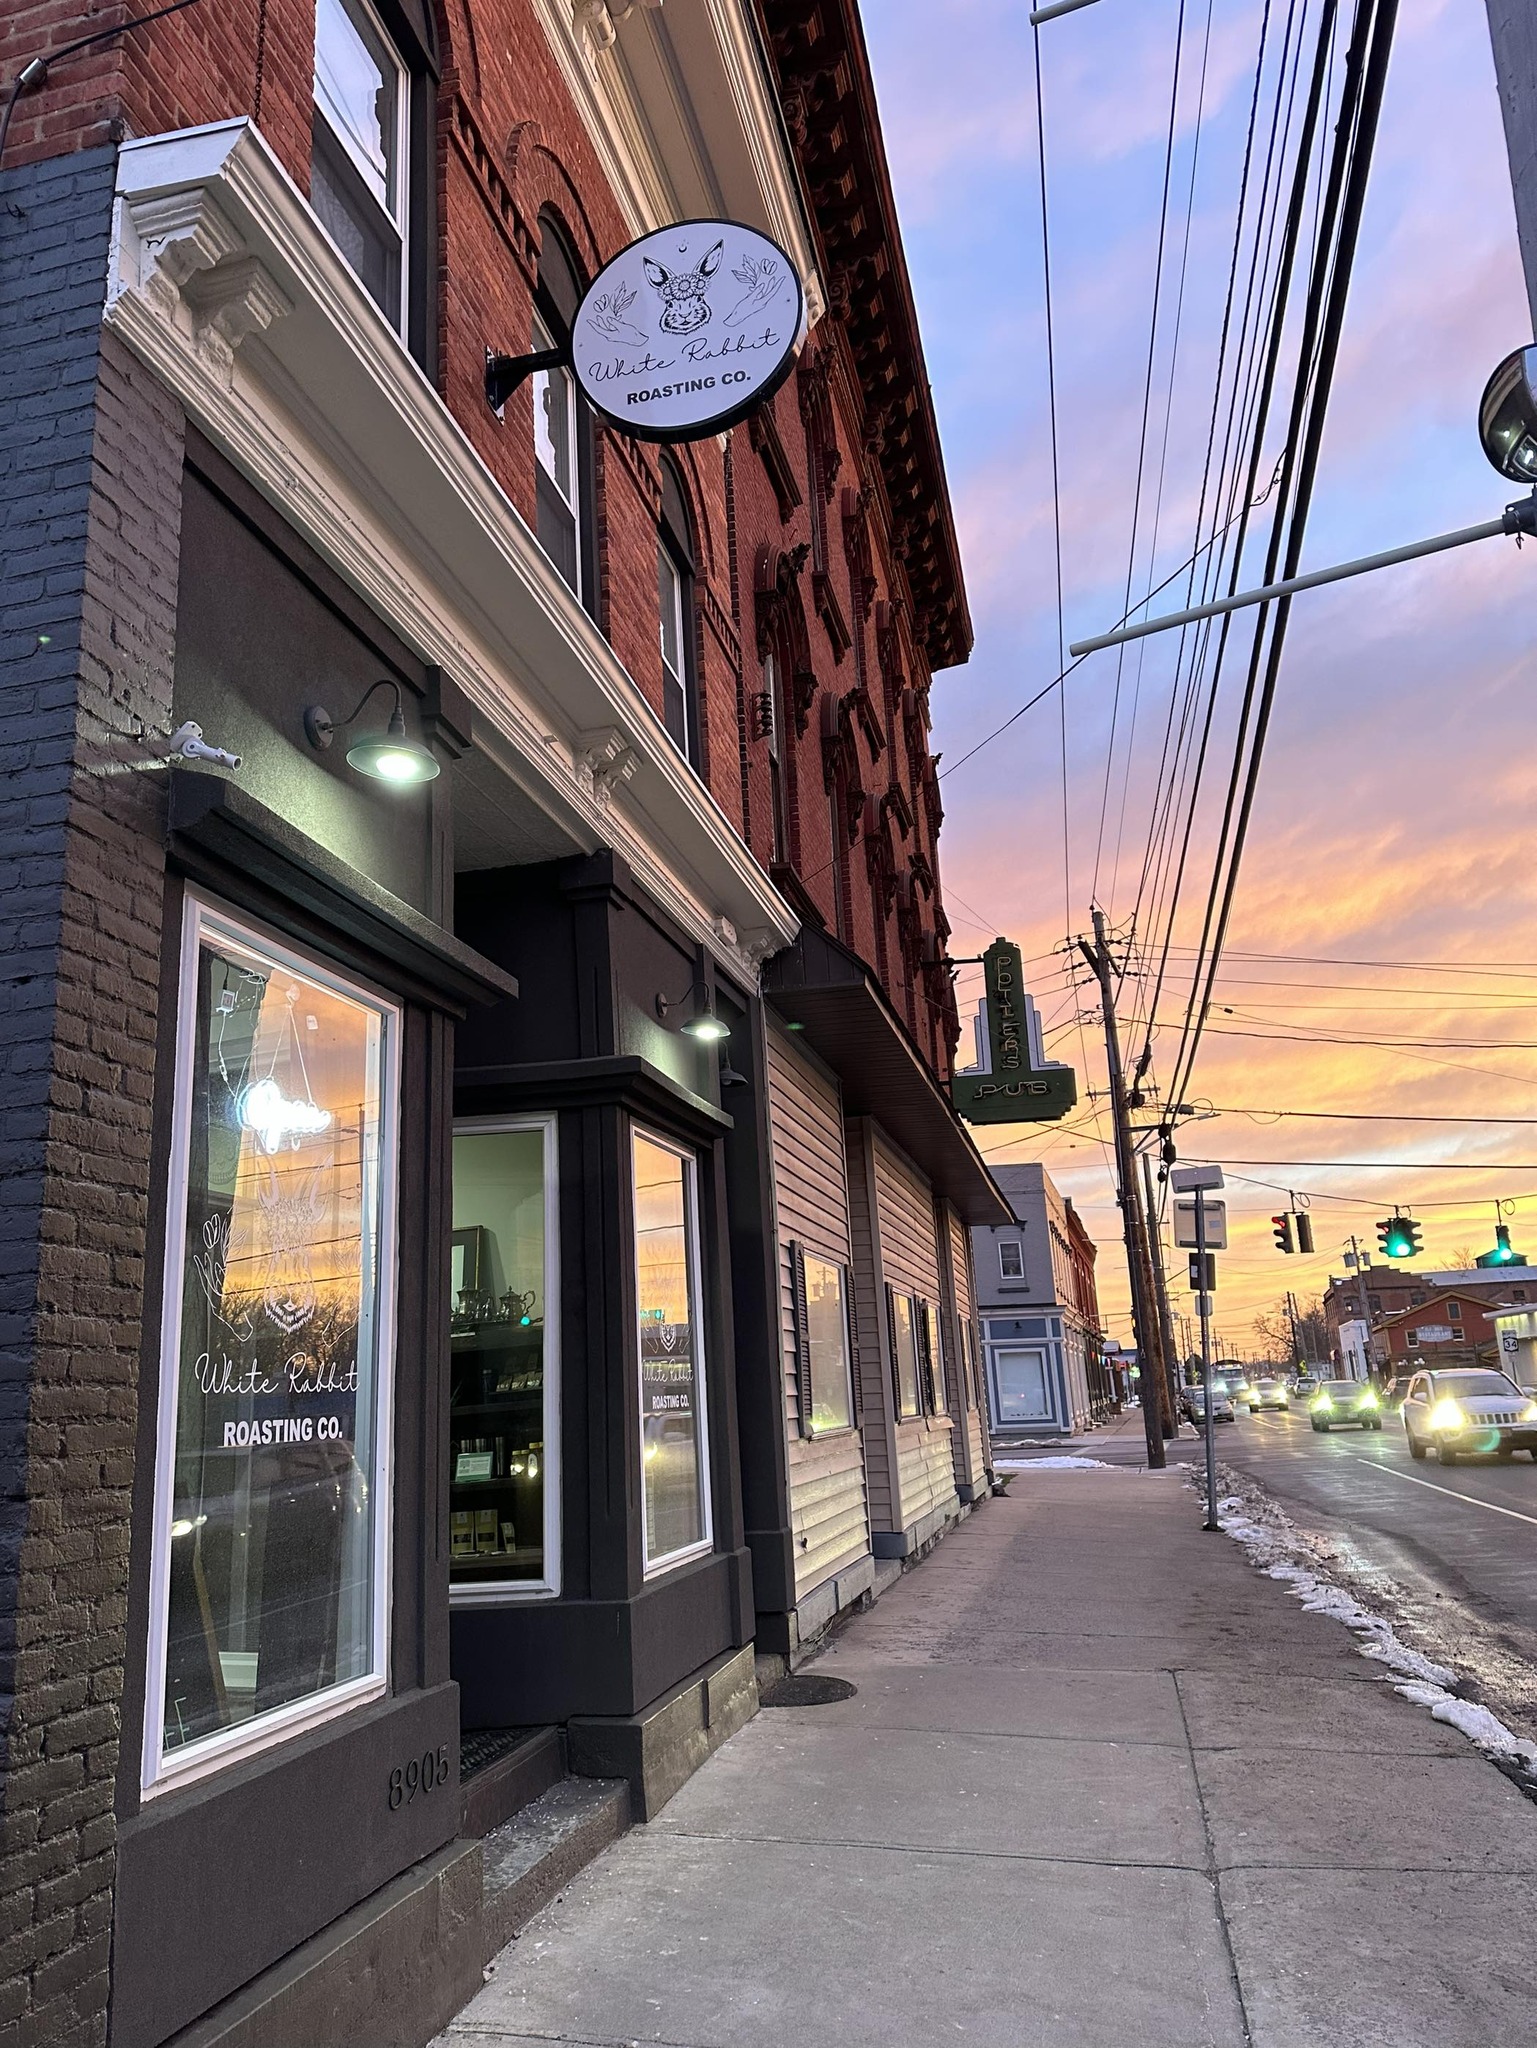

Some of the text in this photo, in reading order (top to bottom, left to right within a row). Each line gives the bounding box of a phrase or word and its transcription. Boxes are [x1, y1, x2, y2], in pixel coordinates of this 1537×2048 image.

[588, 328, 780, 382] White Rabbit
[627, 370, 751, 405] ROASTING CO.
[974, 1080, 1048, 1099] PUB
[1505, 1340, 1517, 1349] 34
[194, 1351, 361, 1394] White Rabbit
[652, 1394, 690, 1410] ROASTING CO.
[223, 1416, 343, 1447] ROASTING CO.
[389, 1742, 450, 1811] 8905
